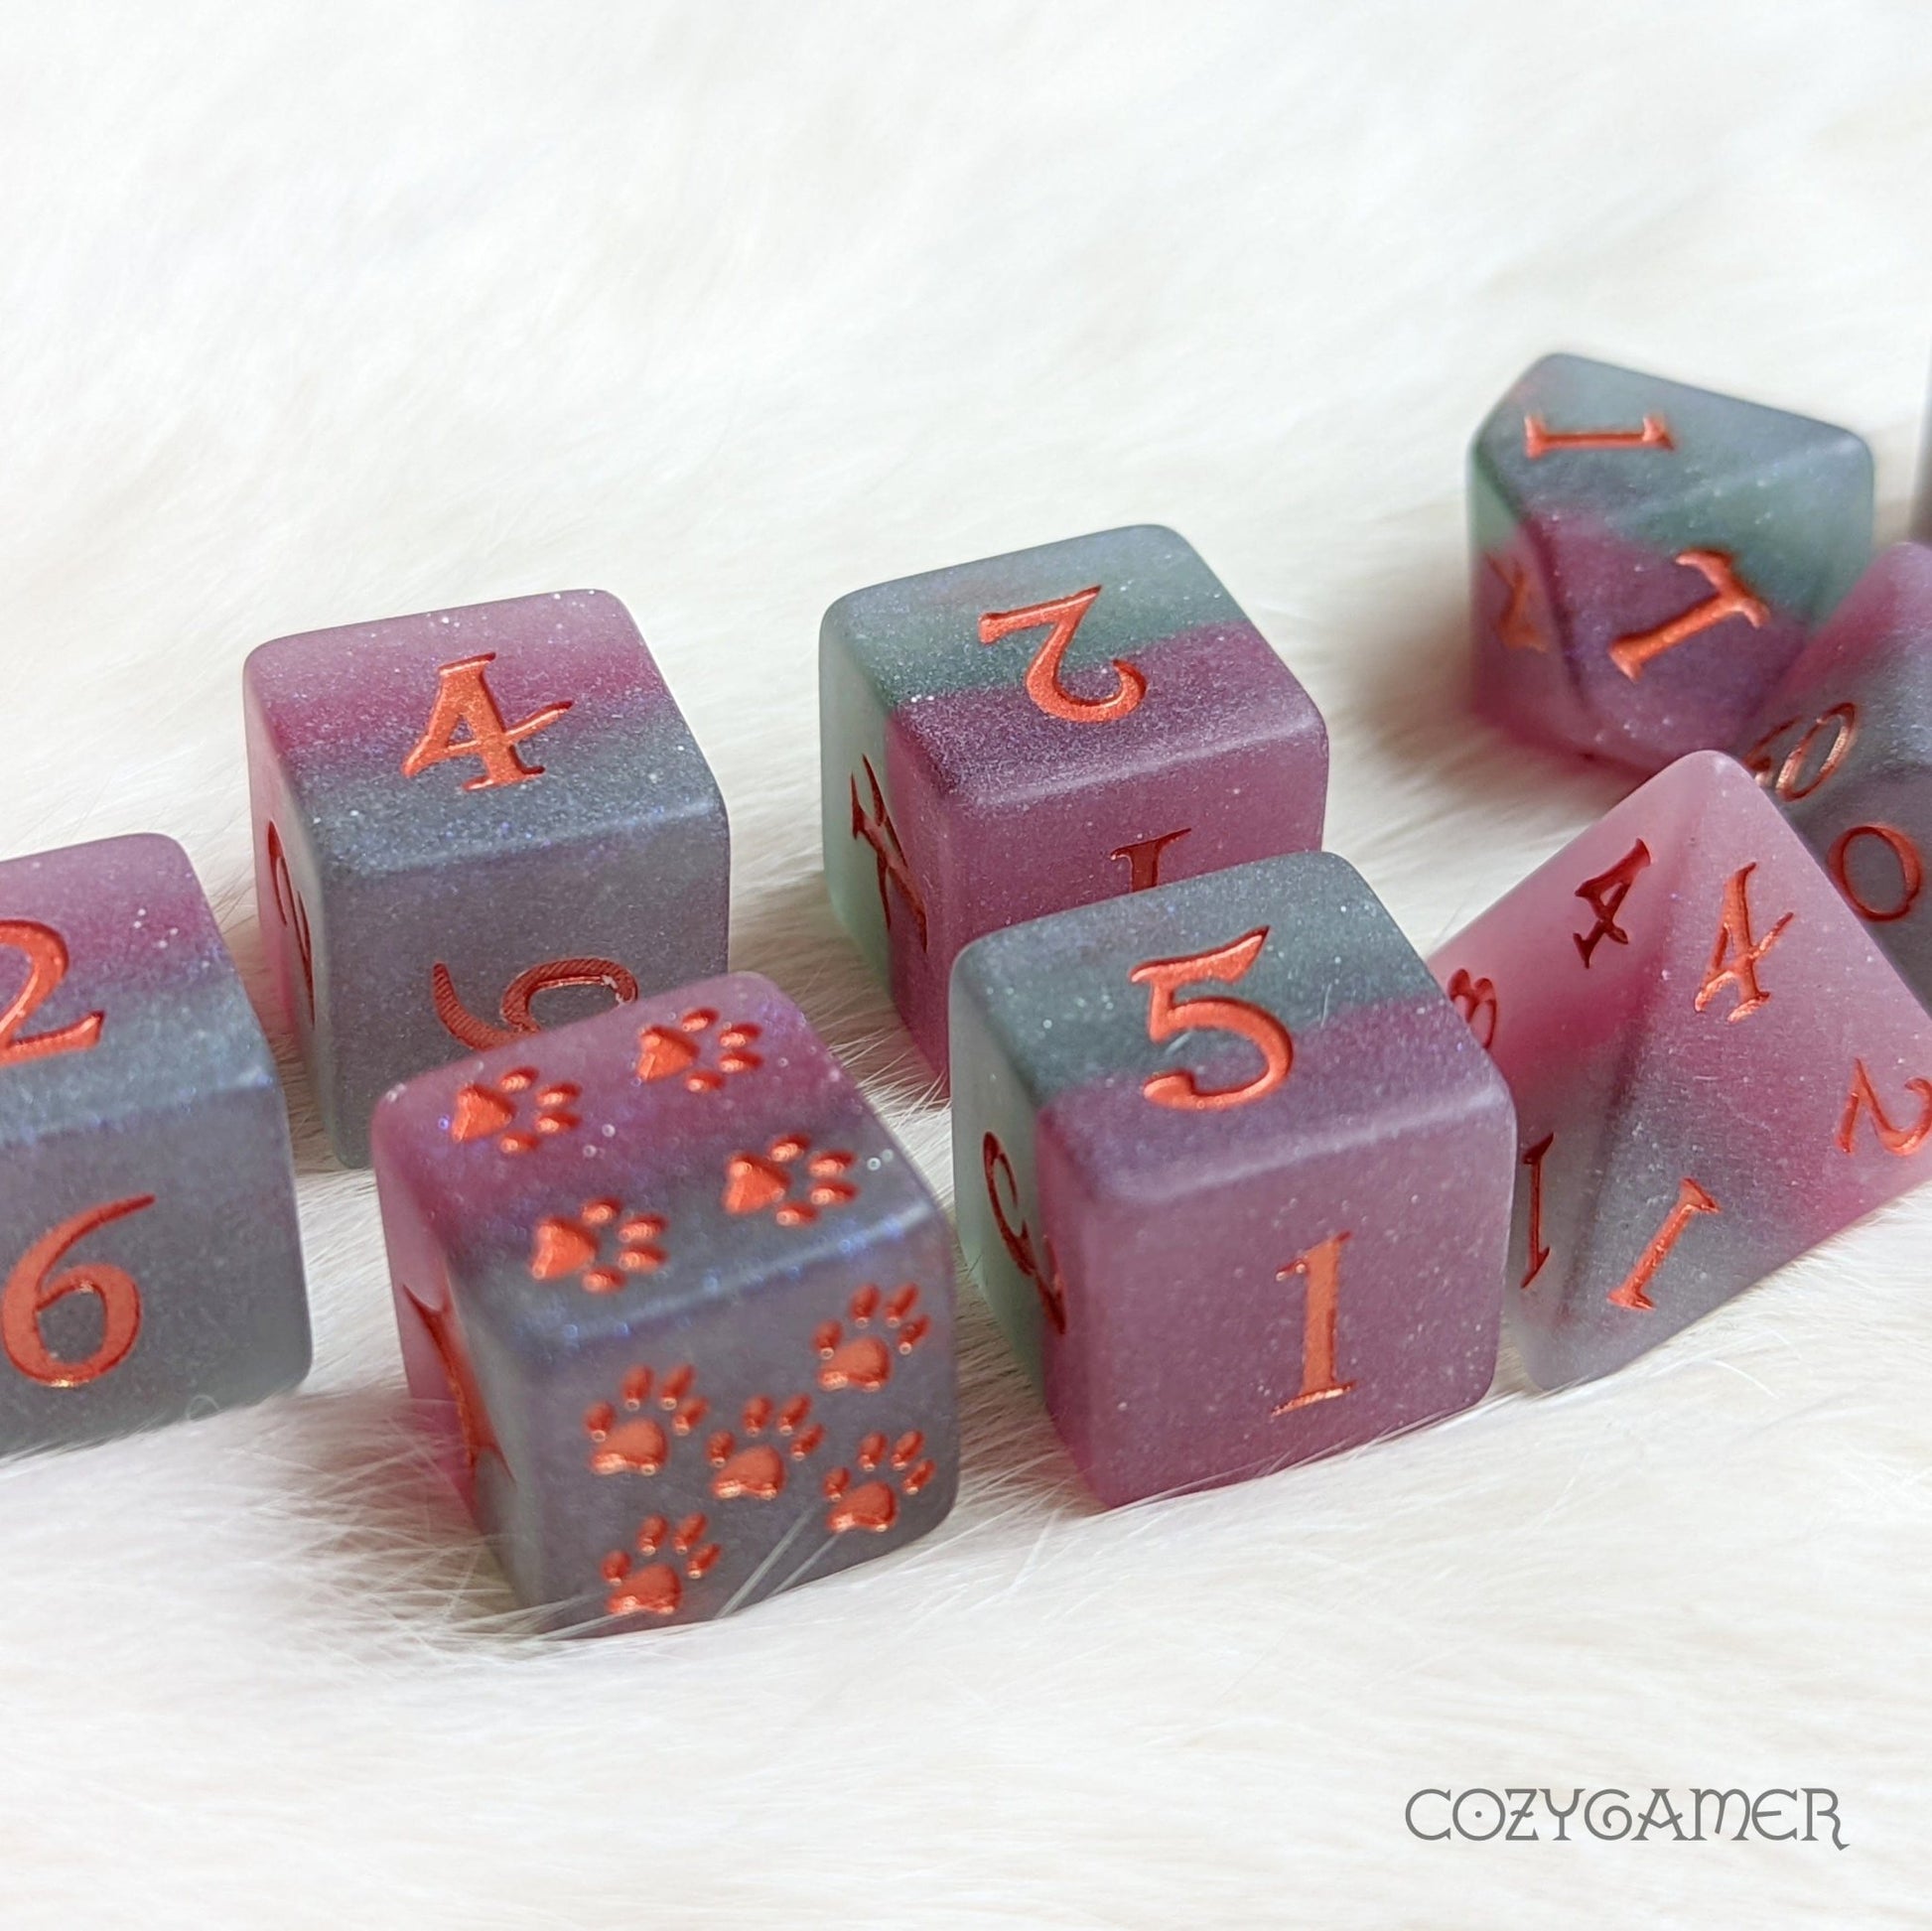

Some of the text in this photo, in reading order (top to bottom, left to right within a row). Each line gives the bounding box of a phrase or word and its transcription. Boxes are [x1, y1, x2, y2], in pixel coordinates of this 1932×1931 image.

[1525, 414, 1676, 459] 1
[403, 651, 575, 791] 4
[977, 585, 1148, 723] 2
[1574, 838, 1652, 970] 4
[1695, 862, 1794, 1024] 4
[1130, 925, 1295, 1111] 5
[1, 1193, 156, 1388] 6
[1270, 1230, 1357, 1417] 1
